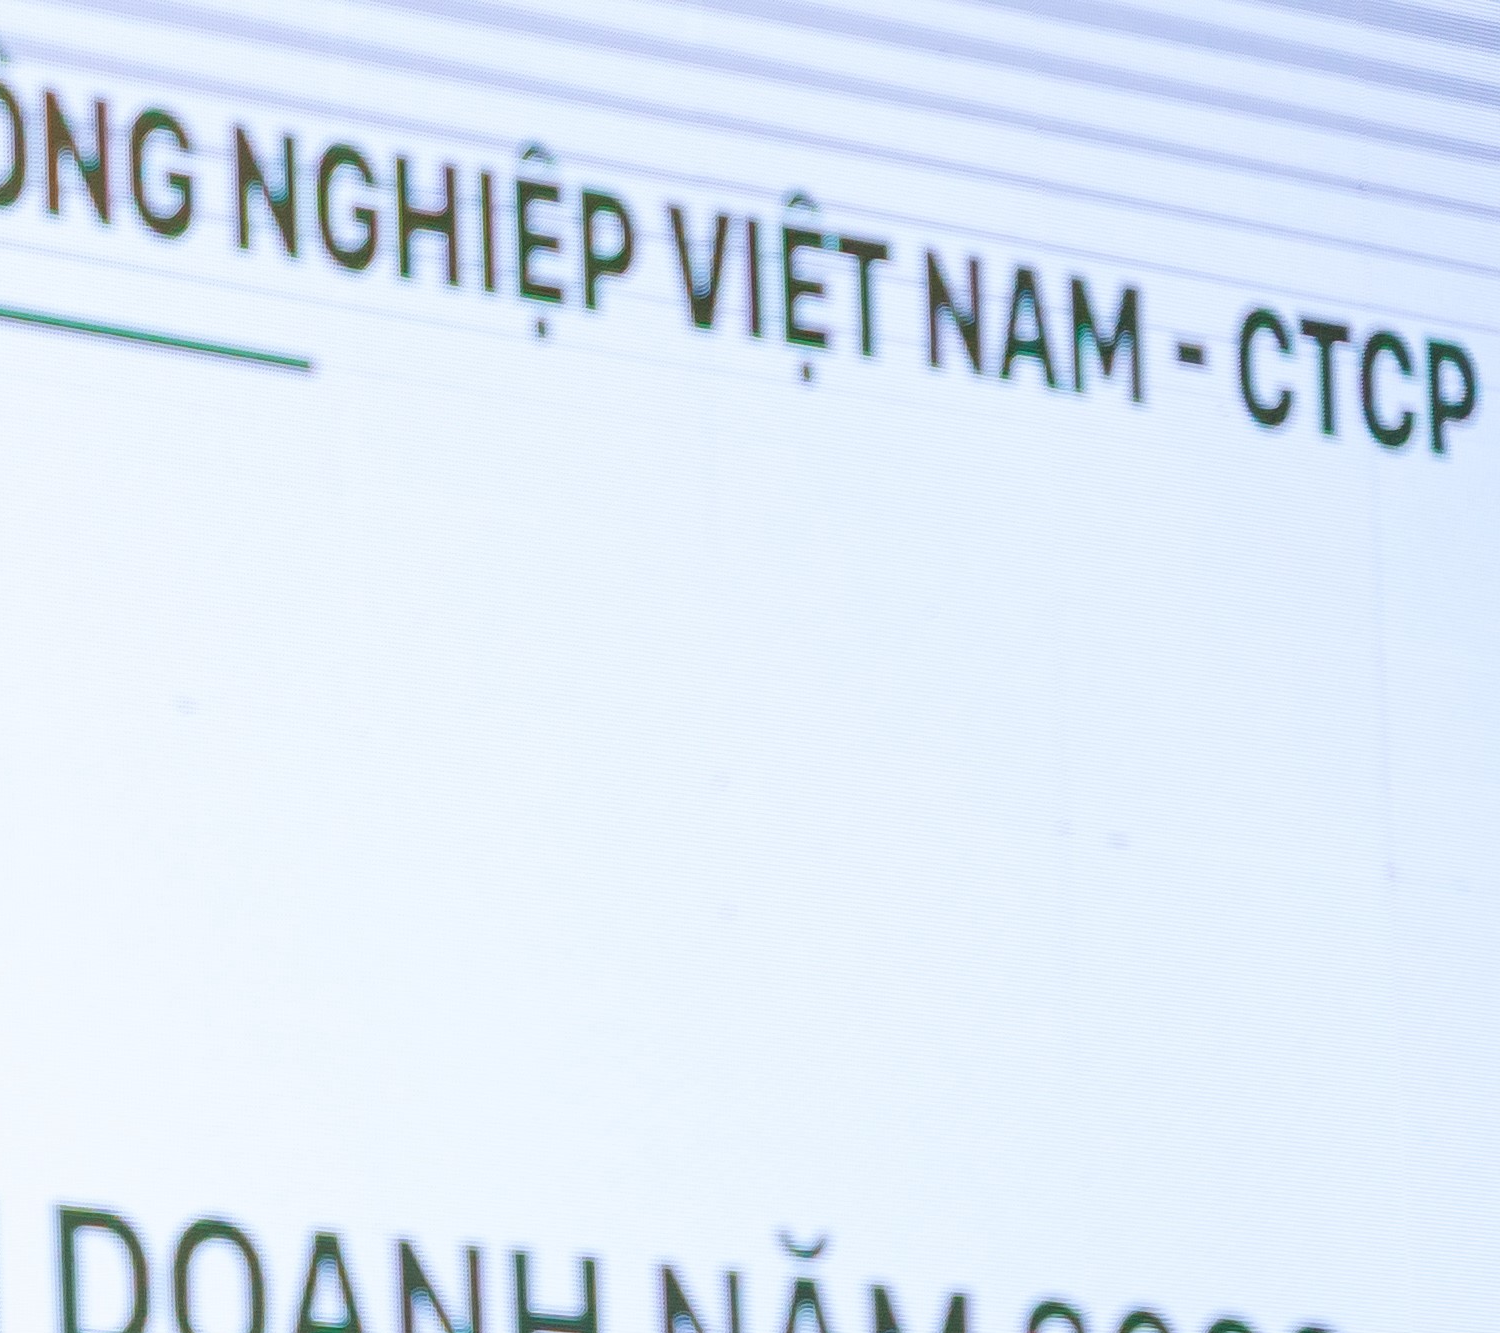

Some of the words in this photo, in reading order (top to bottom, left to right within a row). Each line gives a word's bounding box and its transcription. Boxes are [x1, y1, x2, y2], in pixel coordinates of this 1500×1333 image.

[234, 122, 636, 340] NGHIỆP
[668, 193, 890, 382] VIỆT
[925, 250, 1143, 403] NAM
[1176, 342, 1206, 366] -
[1237, 307, 1478, 455] CTCP
